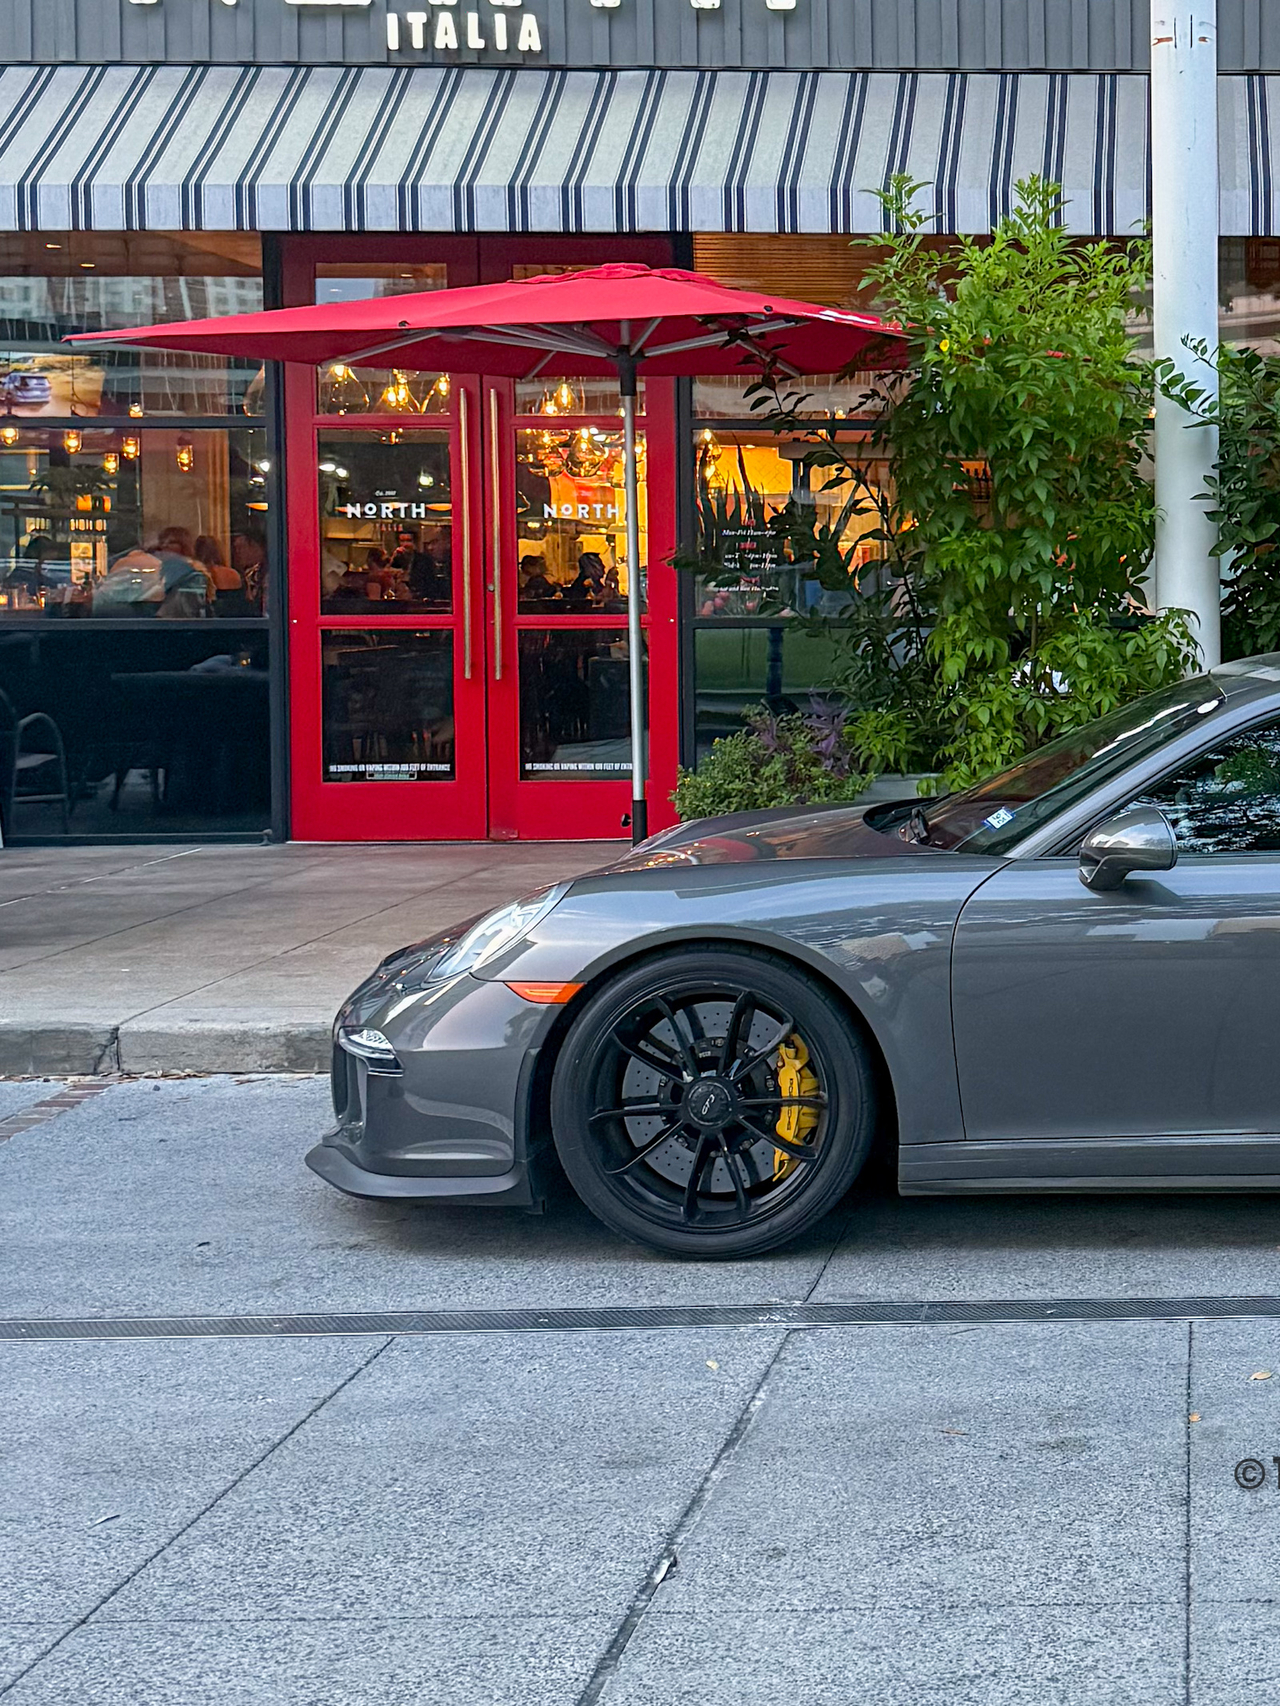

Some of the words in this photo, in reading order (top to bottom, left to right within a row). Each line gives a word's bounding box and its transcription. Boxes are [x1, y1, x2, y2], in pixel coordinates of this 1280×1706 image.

[386, 11, 542, 51] ITALIA
[346, 502, 426, 519] NORTH
[543, 503, 620, 519] NORTH
